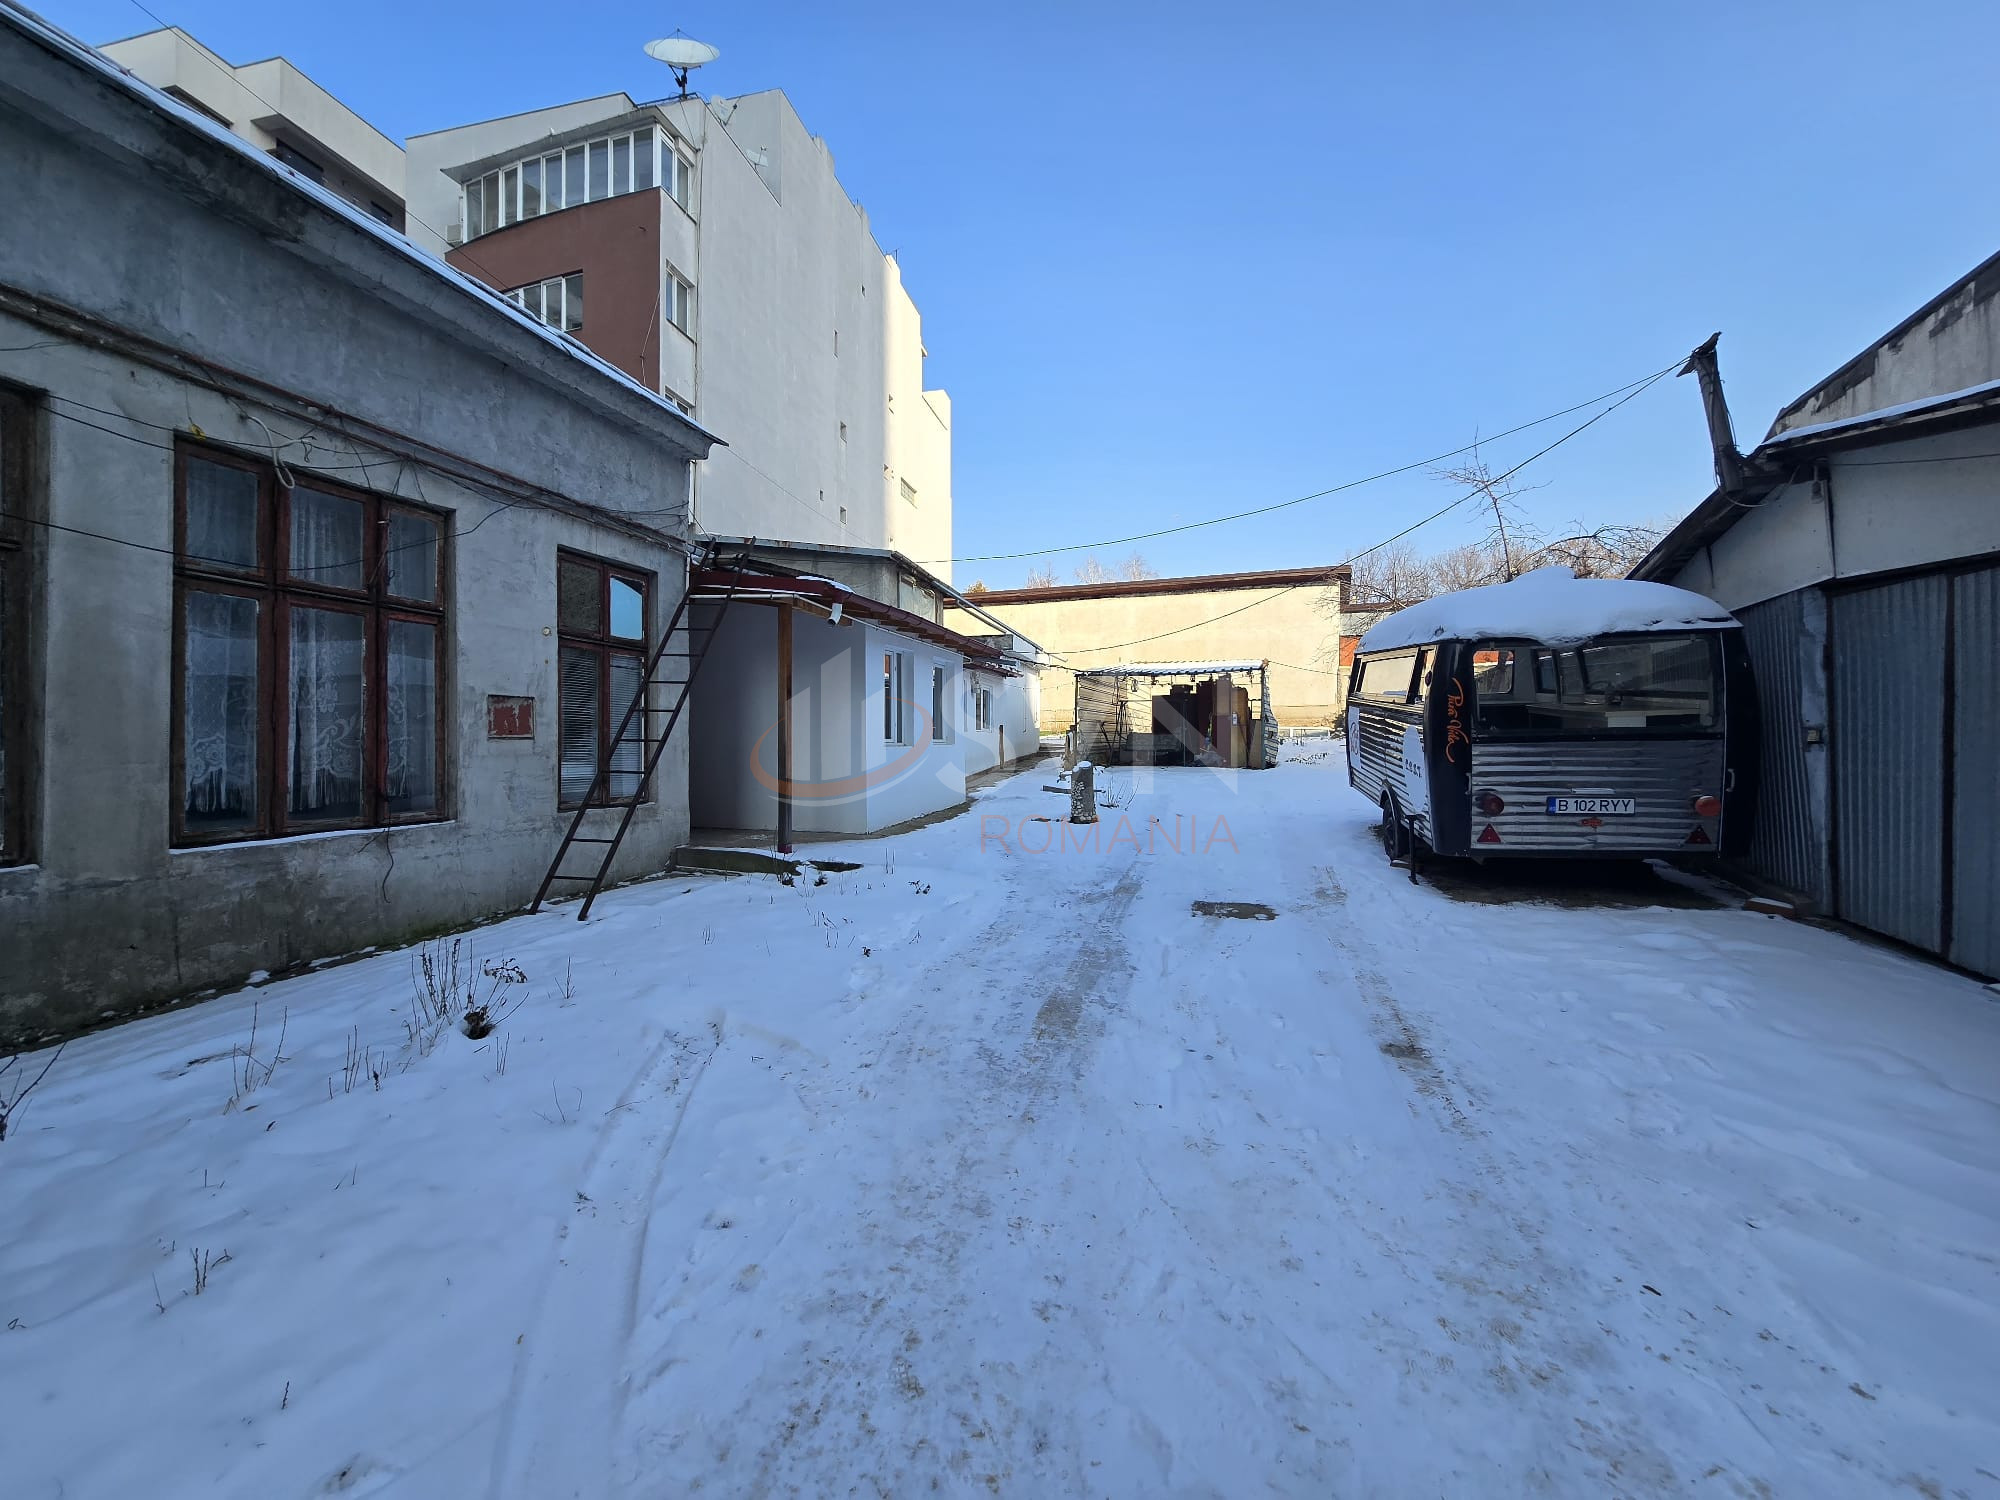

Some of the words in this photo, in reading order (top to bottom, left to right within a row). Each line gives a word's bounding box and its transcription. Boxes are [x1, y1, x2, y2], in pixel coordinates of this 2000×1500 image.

[1558, 799, 1569, 812] B
[1573, 799, 1596, 812] 102
[1599, 799, 1631, 812] RYY
